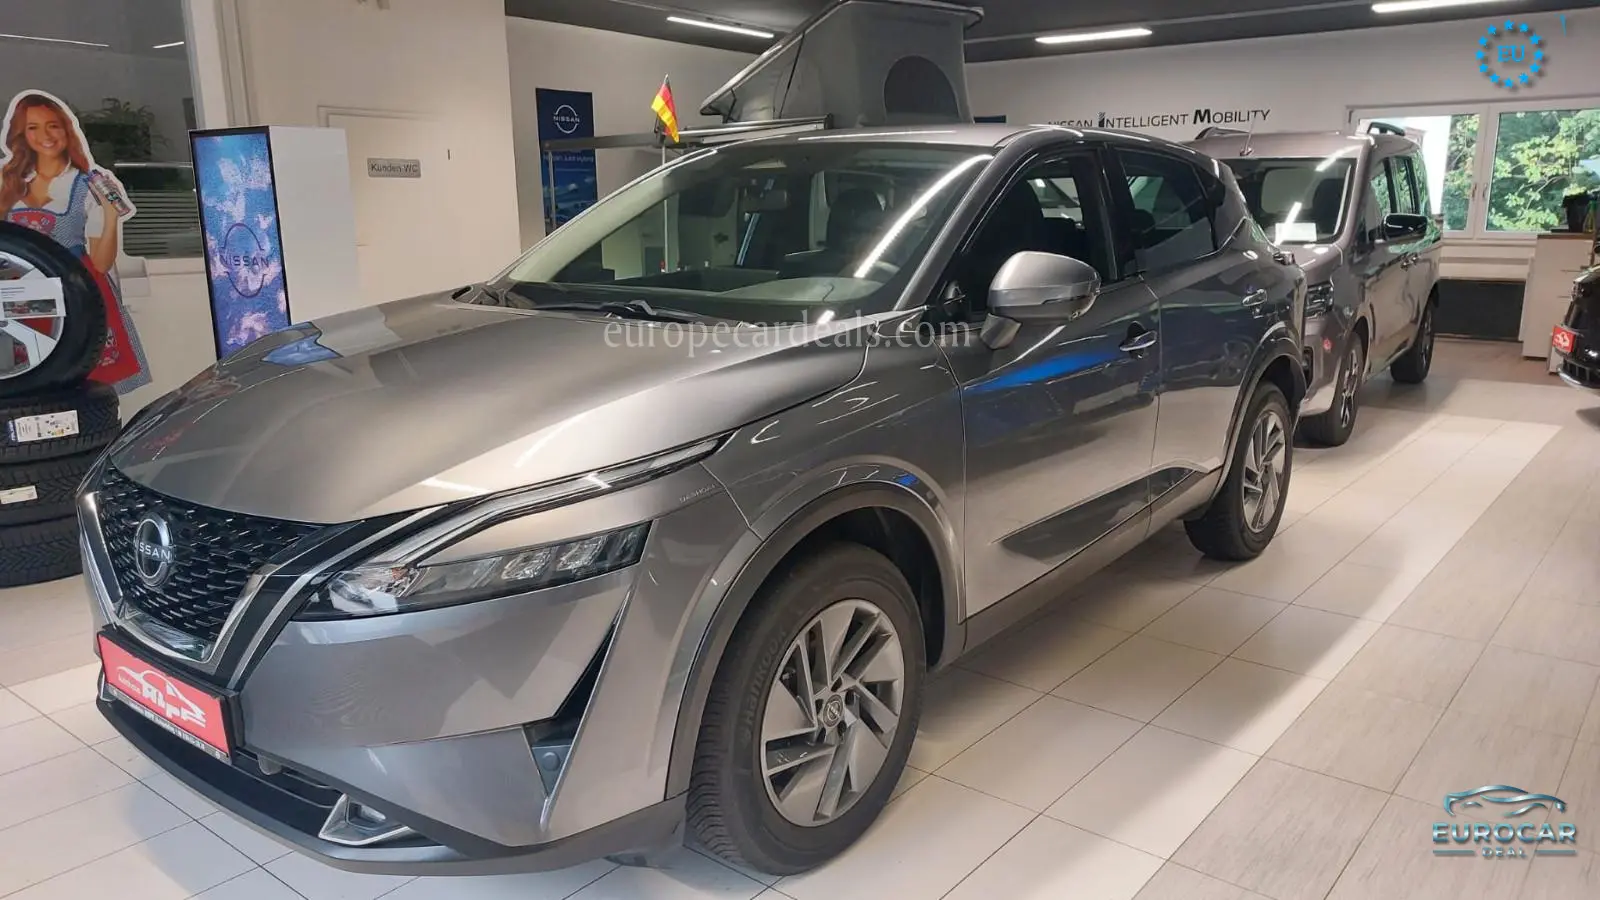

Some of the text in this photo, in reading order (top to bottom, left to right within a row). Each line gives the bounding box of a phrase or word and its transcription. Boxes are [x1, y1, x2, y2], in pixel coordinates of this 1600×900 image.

[553, 115, 581, 123] NISSAN
[1099, 112, 1189, 128] INTELLIGENT
[1193, 109, 1271, 125] MOBILITY
[371, 163, 418, 173] Kunden-WC
[220, 254, 269, 268] NISSAN
[134, 540, 171, 564] SSAN
